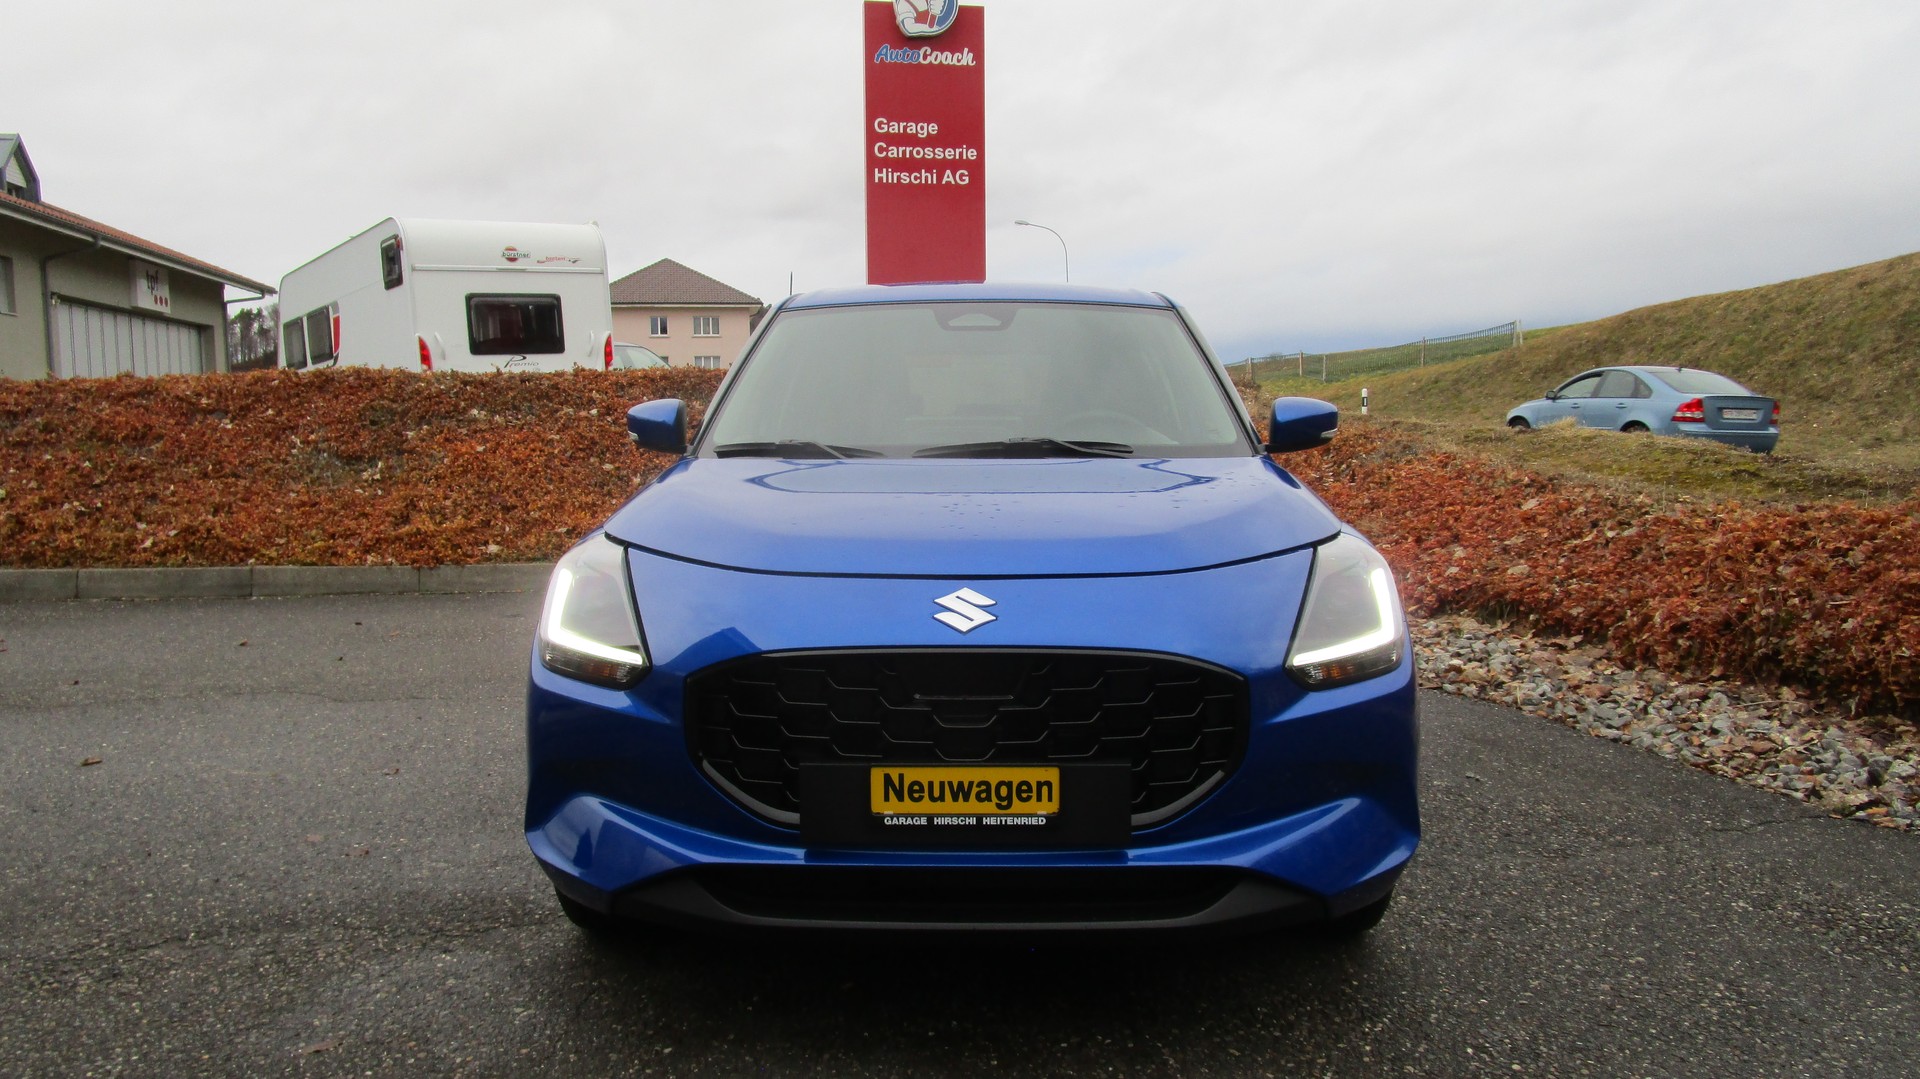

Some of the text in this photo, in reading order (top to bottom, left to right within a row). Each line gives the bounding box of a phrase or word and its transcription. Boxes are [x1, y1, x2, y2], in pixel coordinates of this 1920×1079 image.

[874, 44, 976, 66] AutoCoach
[874, 117, 939, 138] Garage
[874, 142, 977, 160] Carrosserie
[874, 168, 970, 185] Hirschi AG
[883, 773, 1053, 810] Neuwagen
[884, 817, 1046, 825] GARAGE HIRSCHI HEITENRIED
